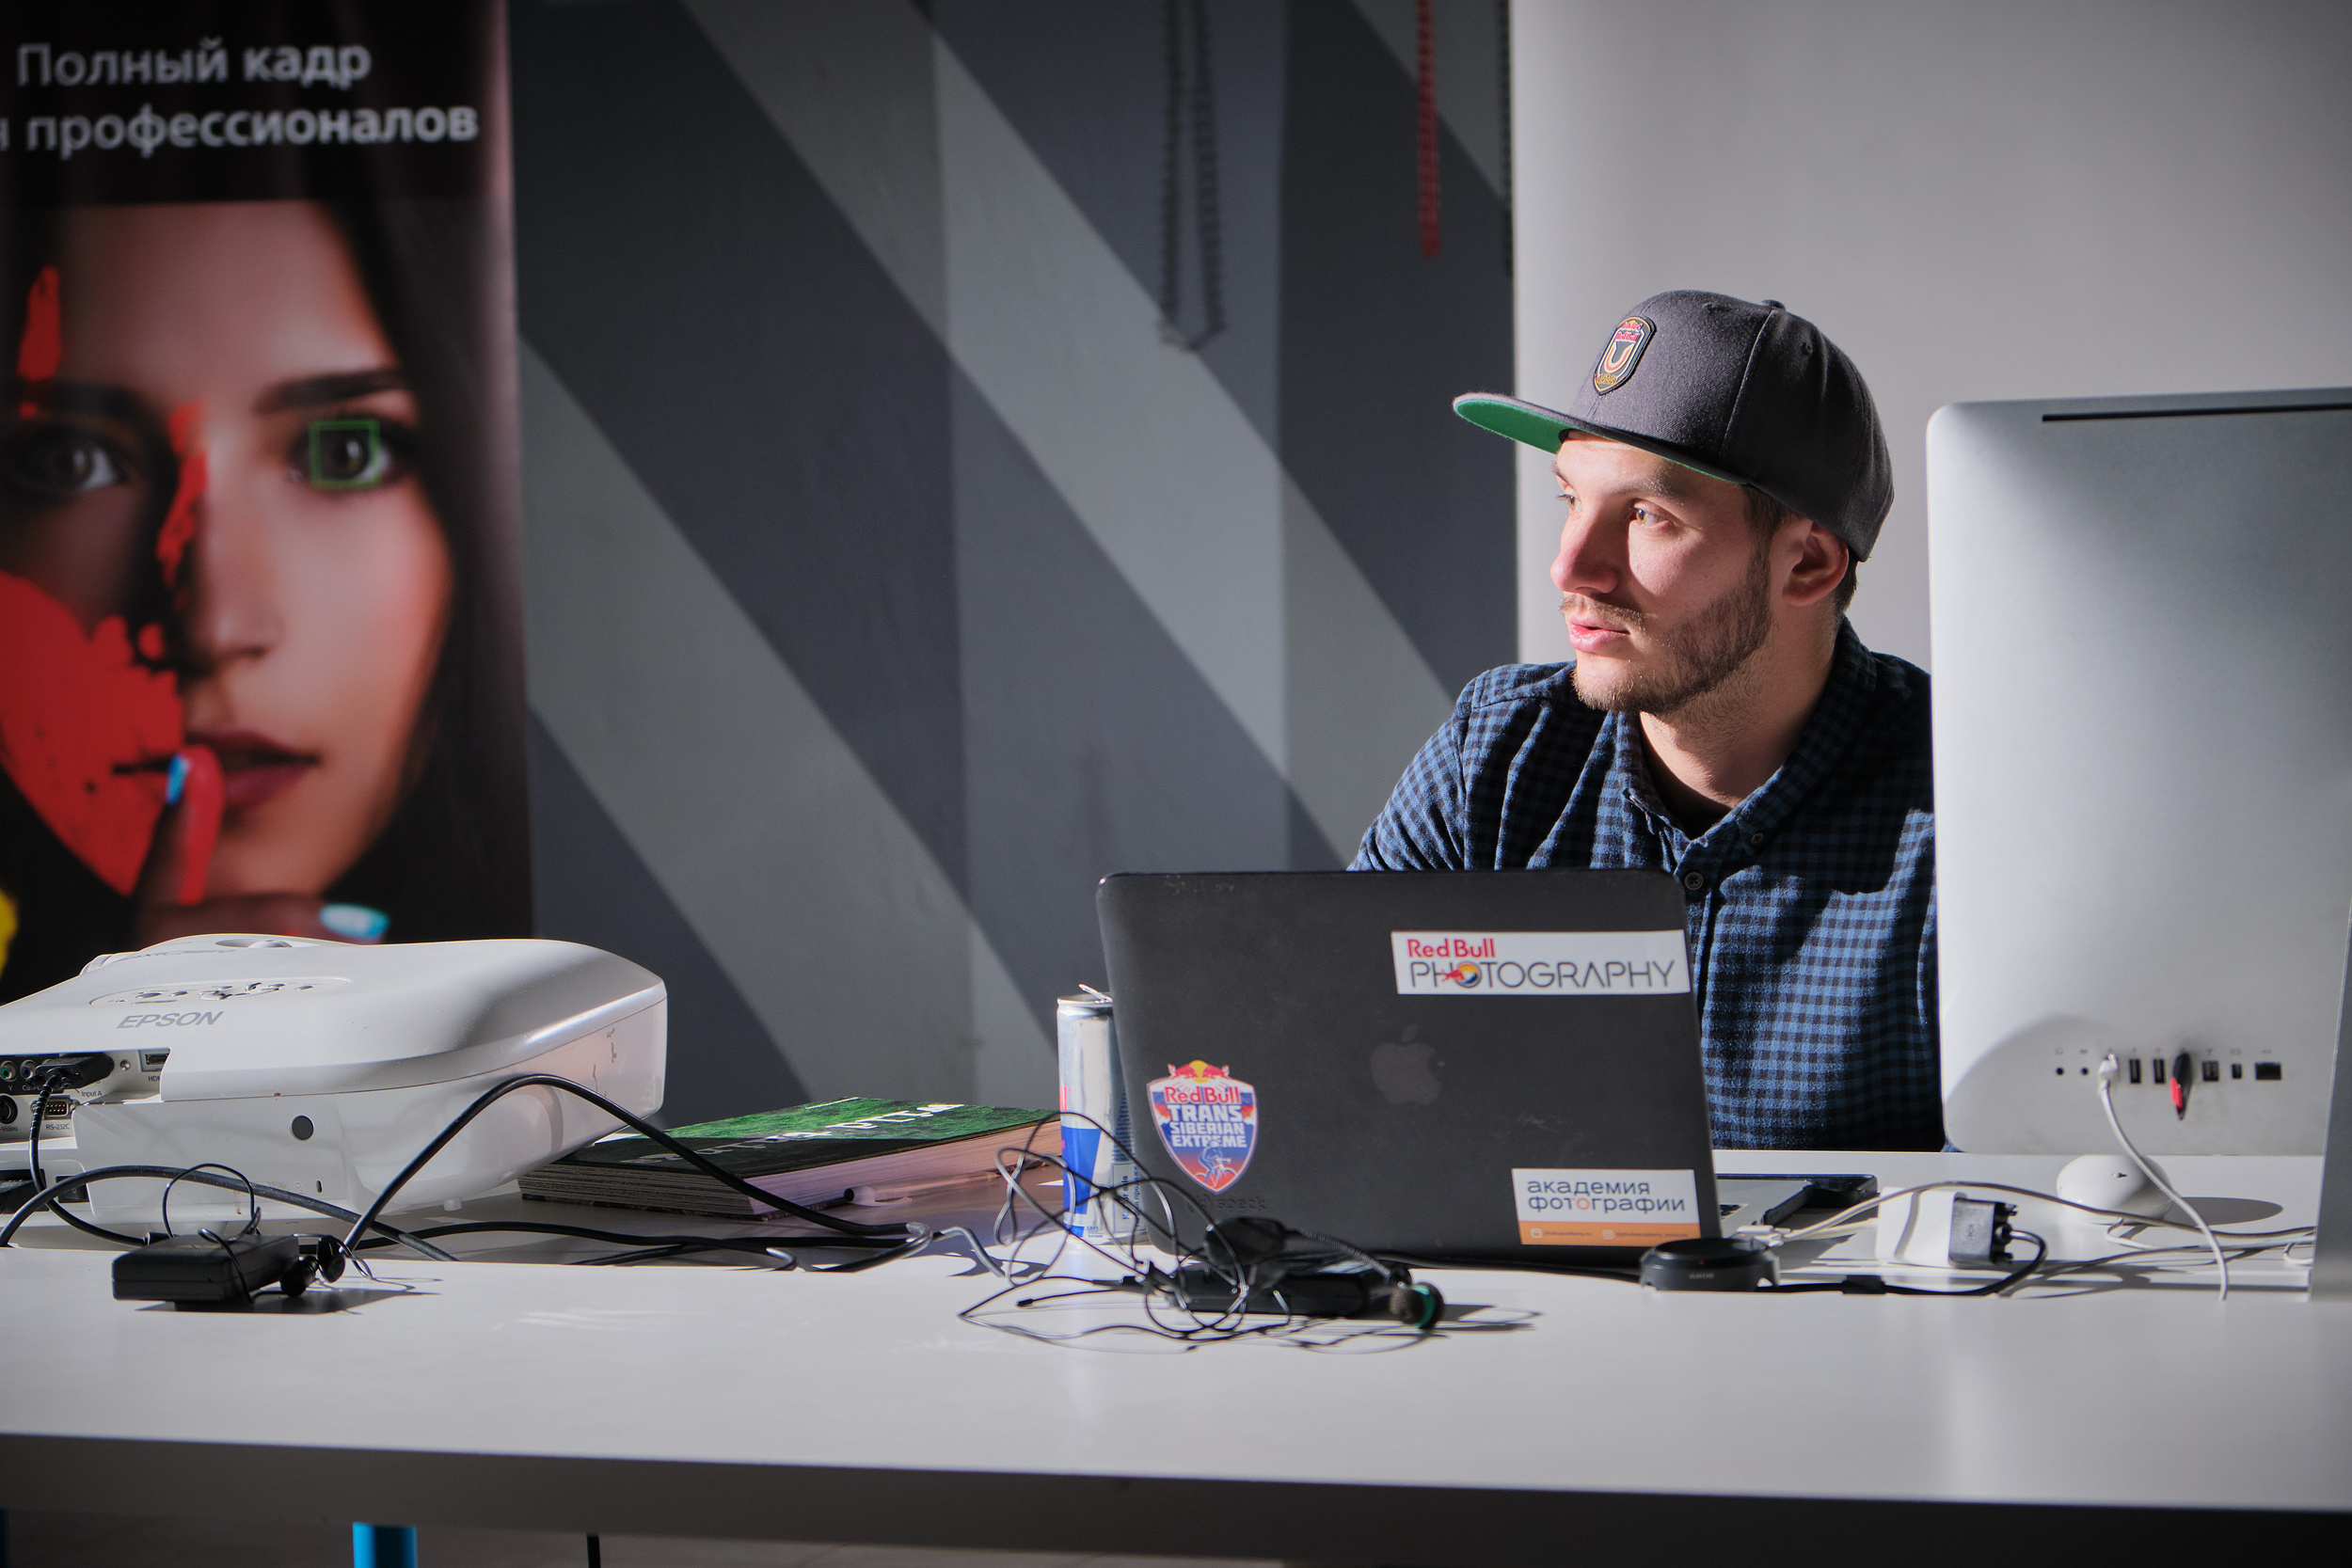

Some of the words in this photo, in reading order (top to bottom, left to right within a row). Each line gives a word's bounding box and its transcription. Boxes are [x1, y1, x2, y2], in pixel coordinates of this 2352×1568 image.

[17, 37, 229, 87] Полный
[243, 44, 373, 89] кадр
[26, 104, 479, 160] профессионалов
[1406, 939, 1450, 958] Red
[1454, 939, 1496, 958] Bull
[1410, 960, 1676, 989] PHOTOGRAPHY
[117, 1011, 224, 1029] EPSON
[1165, 1086, 1201, 1102] Red
[1203, 1086, 1240, 1103] Bull
[1167, 1104, 1243, 1122] TRANS
[1169, 1122, 1246, 1135] SIBERIAN
[1171, 1134, 1248, 1148] EXTREME
[1527, 1180, 1650, 1196] академия
[1528, 1196, 1685, 1213] фотографии
